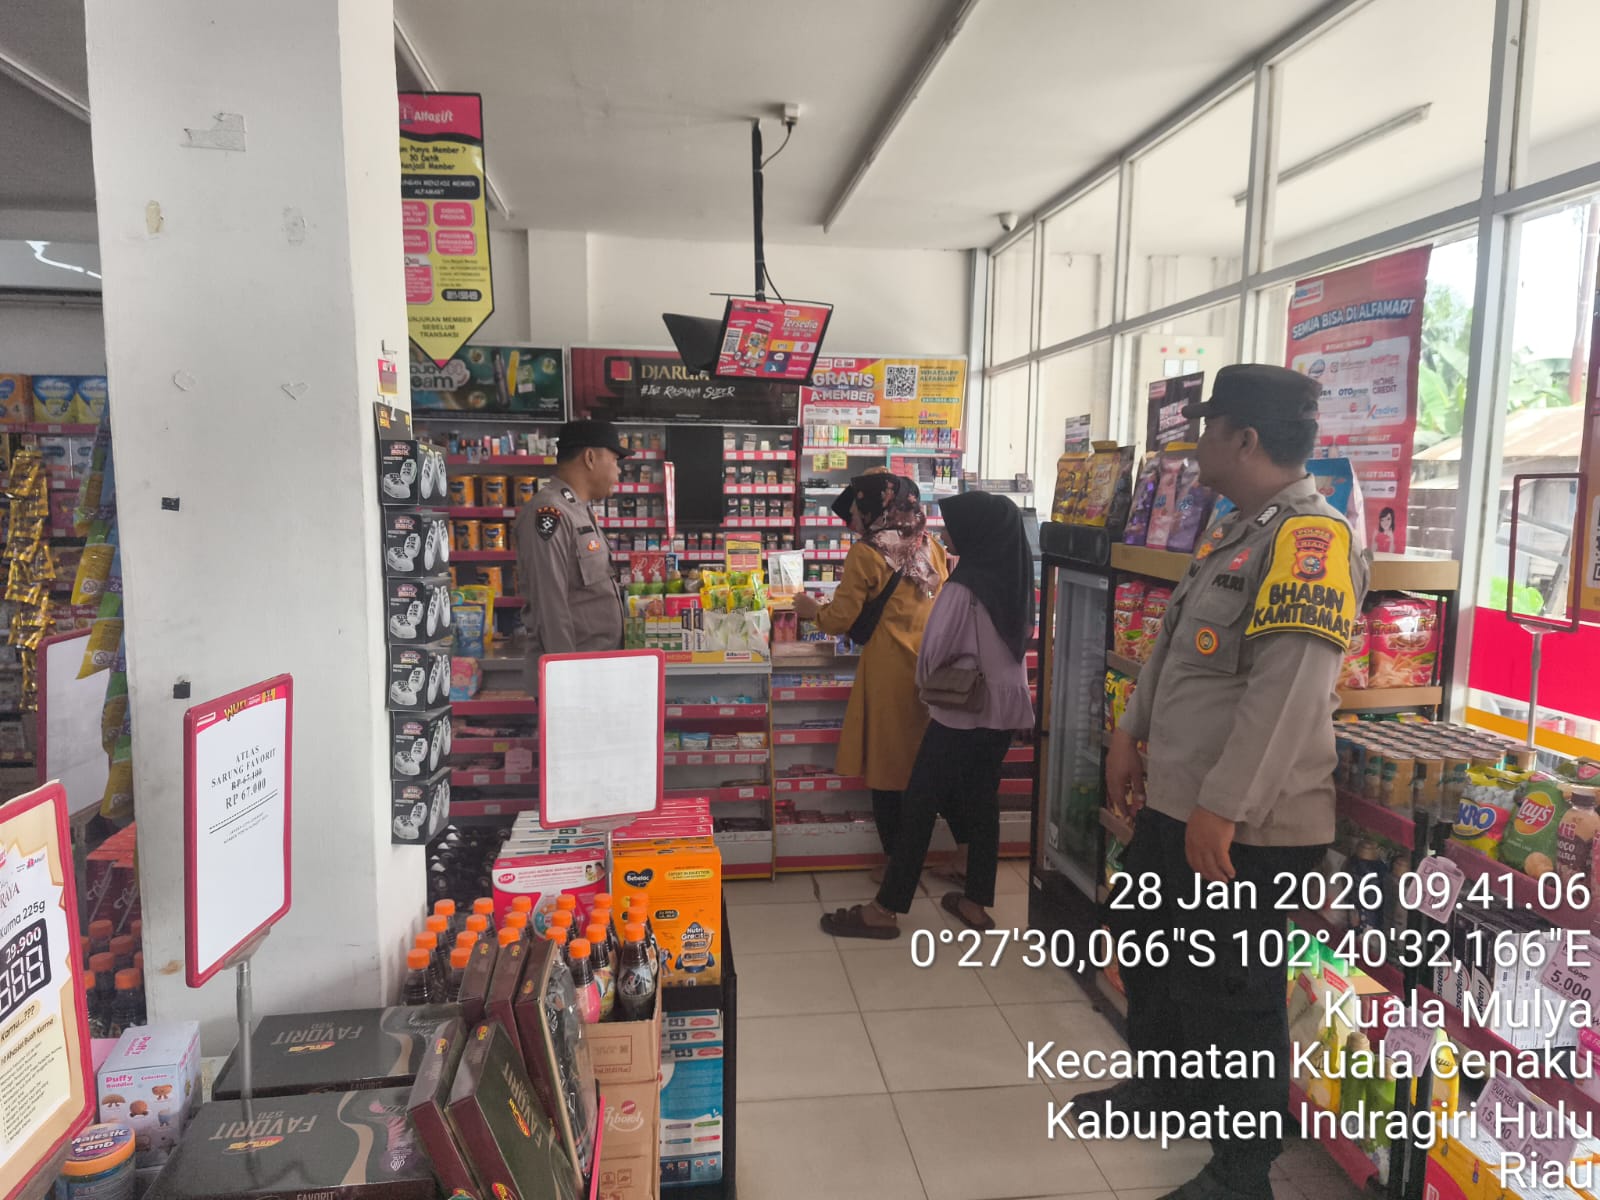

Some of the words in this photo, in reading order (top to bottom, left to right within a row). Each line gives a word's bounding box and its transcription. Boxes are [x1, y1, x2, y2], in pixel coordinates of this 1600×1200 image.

[432, 146, 459, 154] Member
[1292, 317, 1320, 339] SEMUA
[1322, 309, 1345, 328] BISA
[1346, 306, 1358, 321] DI
[1359, 299, 1416, 319] ALFAMART
[641, 364, 711, 381] DJARU
[812, 371, 875, 388] GRATIS
[1269, 581, 1345, 613] BHABIN
[1253, 602, 1351, 641] KAMTIBMAS
[211, 764, 244, 788] SARUNG
[246, 748, 277, 771] FAVORIT
[235, 745, 261, 764] ATLAS
[225, 793, 239, 810] RP
[241, 777, 267, 801] 67.000
[1458, 802, 1495, 829] KRO
[1517, 798, 1552, 825] Lay's
[22, 900, 46, 920] 225g
[687, 927, 704, 935] Nutri
[1550, 969, 1592, 1001] 5.000
[270, 1026, 364, 1046] FAVORIT
[105, 1074, 133, 1084] Puffy
[208, 1114, 319, 1141] FAVORIT
[1481, 1106, 1512, 1140] 15.00
